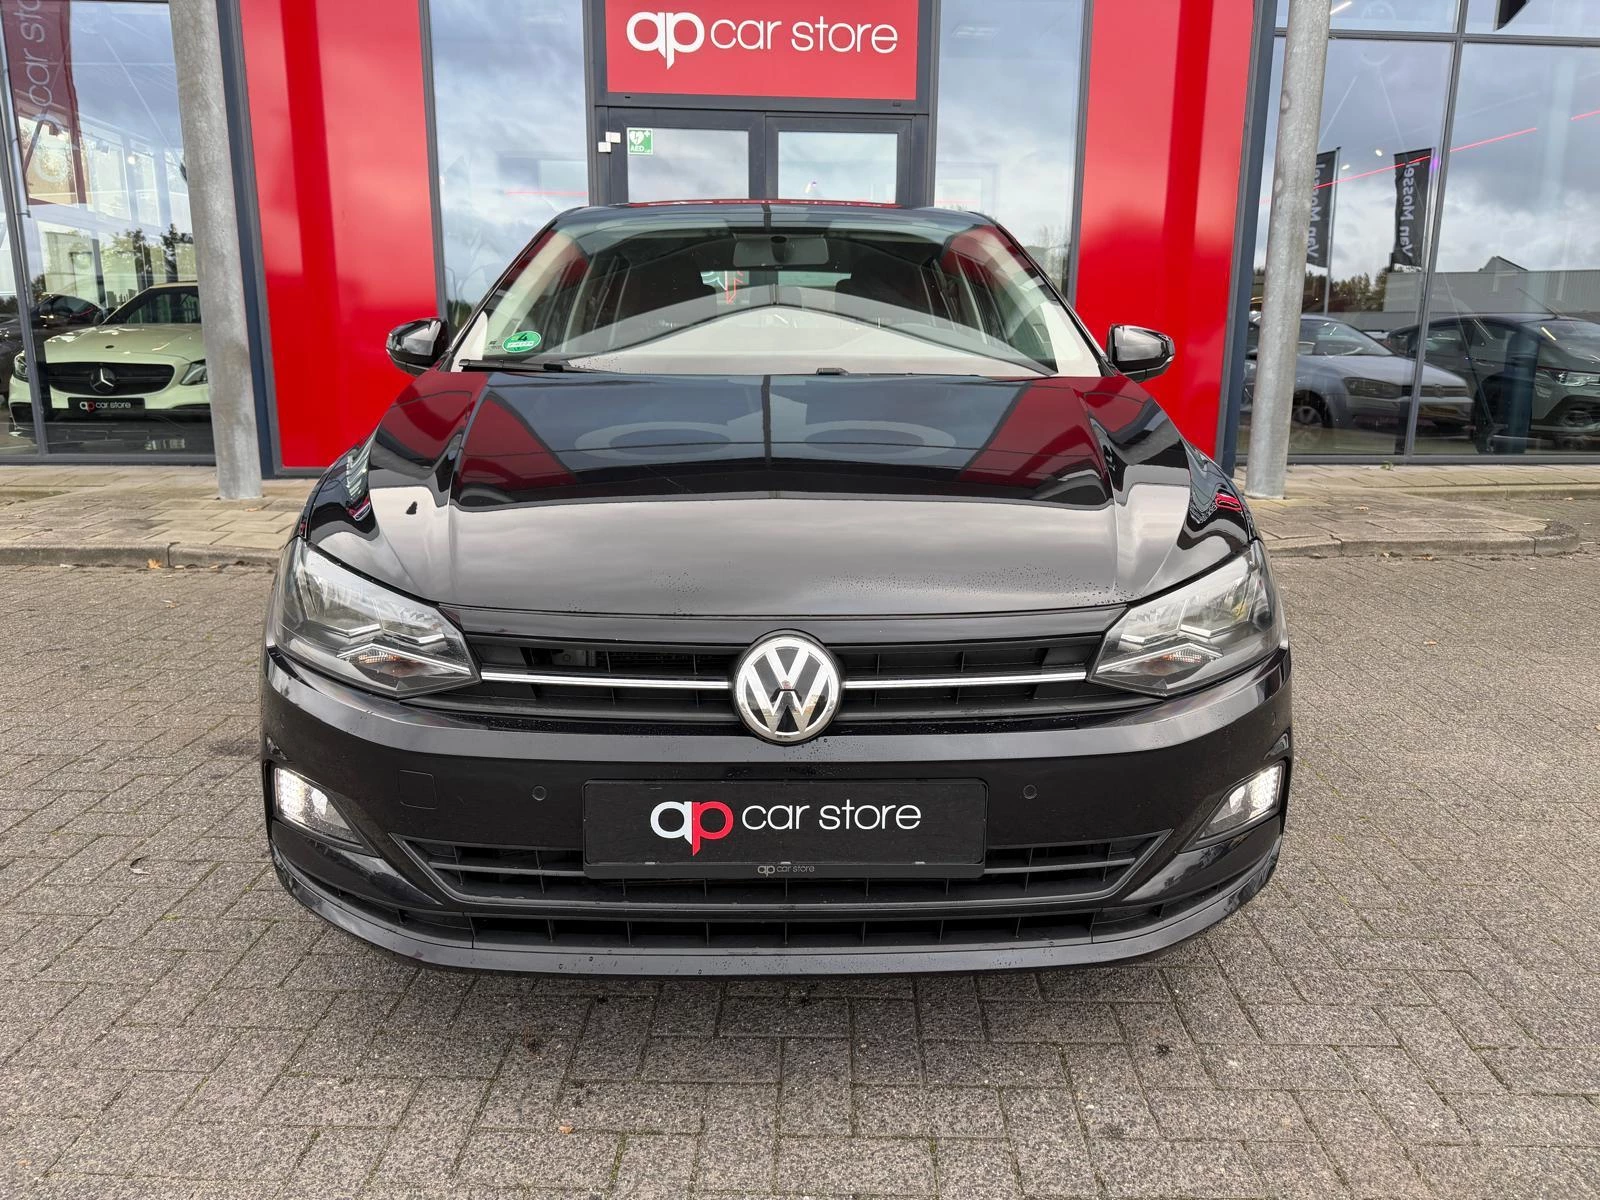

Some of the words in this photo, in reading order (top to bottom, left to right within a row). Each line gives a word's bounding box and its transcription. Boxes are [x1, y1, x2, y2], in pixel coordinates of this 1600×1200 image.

[626, 11, 705, 69] ap
[710, 18, 782, 51] car
[791, 16, 898, 54] store
[110, 401, 132, 409] store
[650, 800, 734, 856] ap
[741, 803, 810, 830] car
[818, 799, 922, 830] store
[776, 865, 791, 873] car
[792, 865, 815, 873] store
